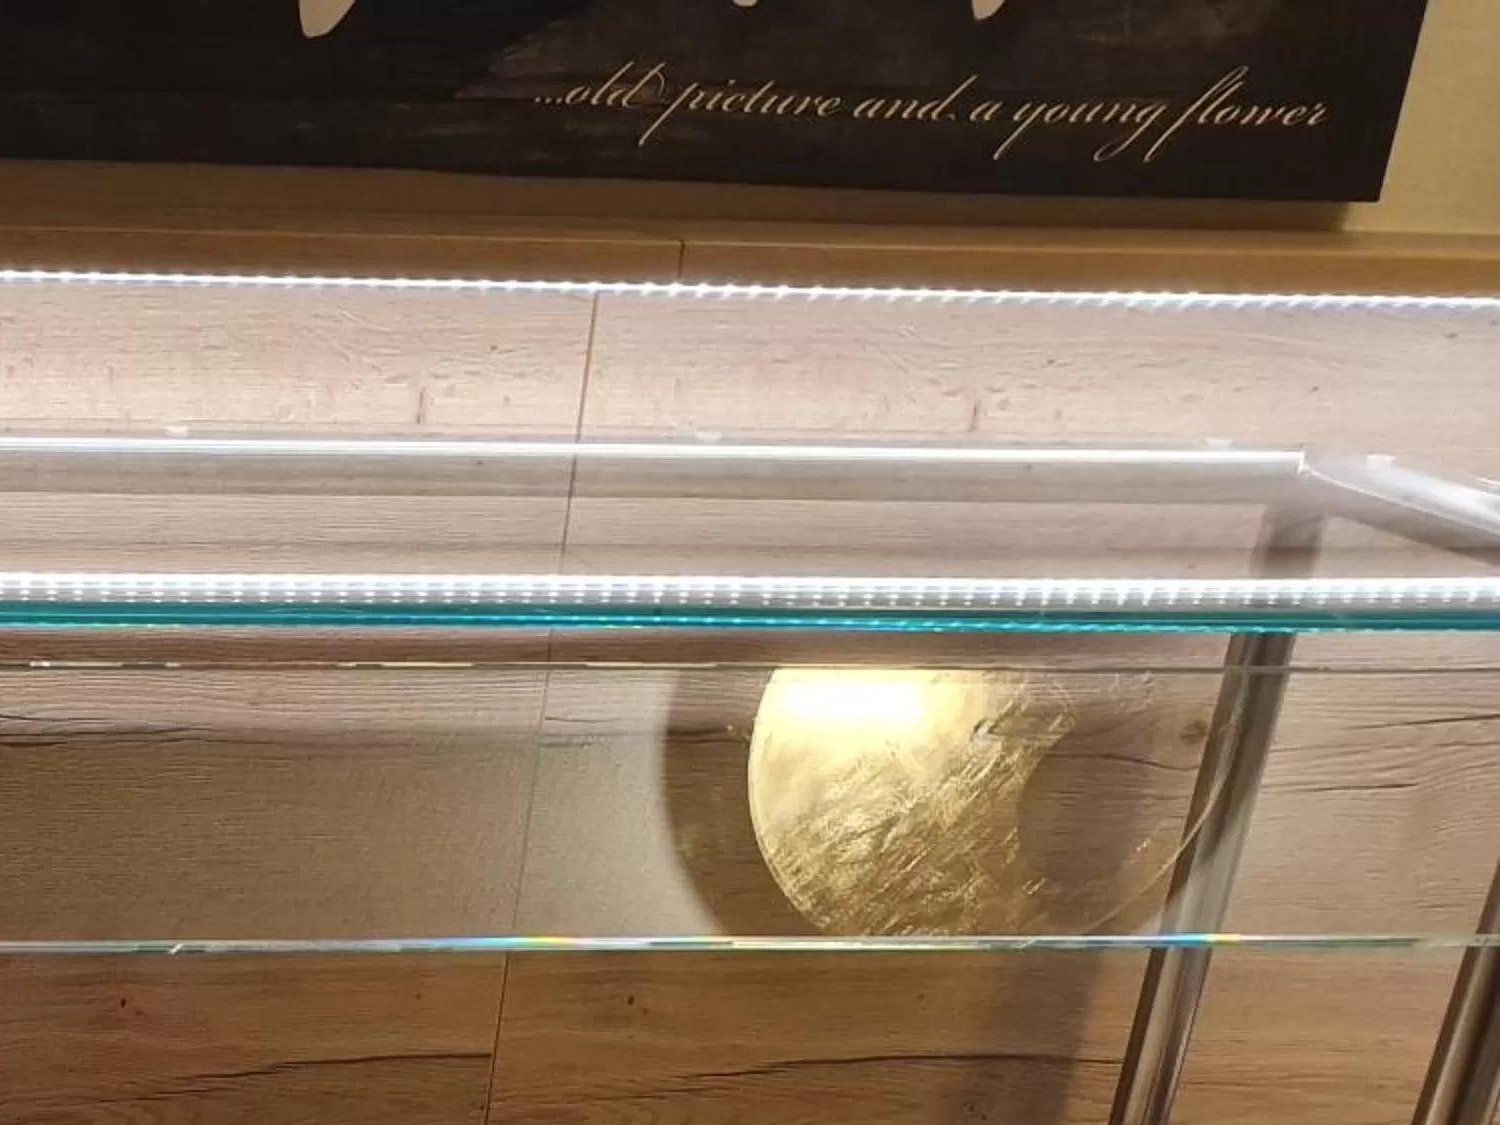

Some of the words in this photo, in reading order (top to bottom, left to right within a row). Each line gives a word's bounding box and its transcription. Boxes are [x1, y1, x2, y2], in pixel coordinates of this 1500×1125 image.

[638, 80, 842, 147] picture
[969, 101, 1003, 122] a
[993, 102, 1168, 162] young
[1143, 65, 1328, 163] flower
